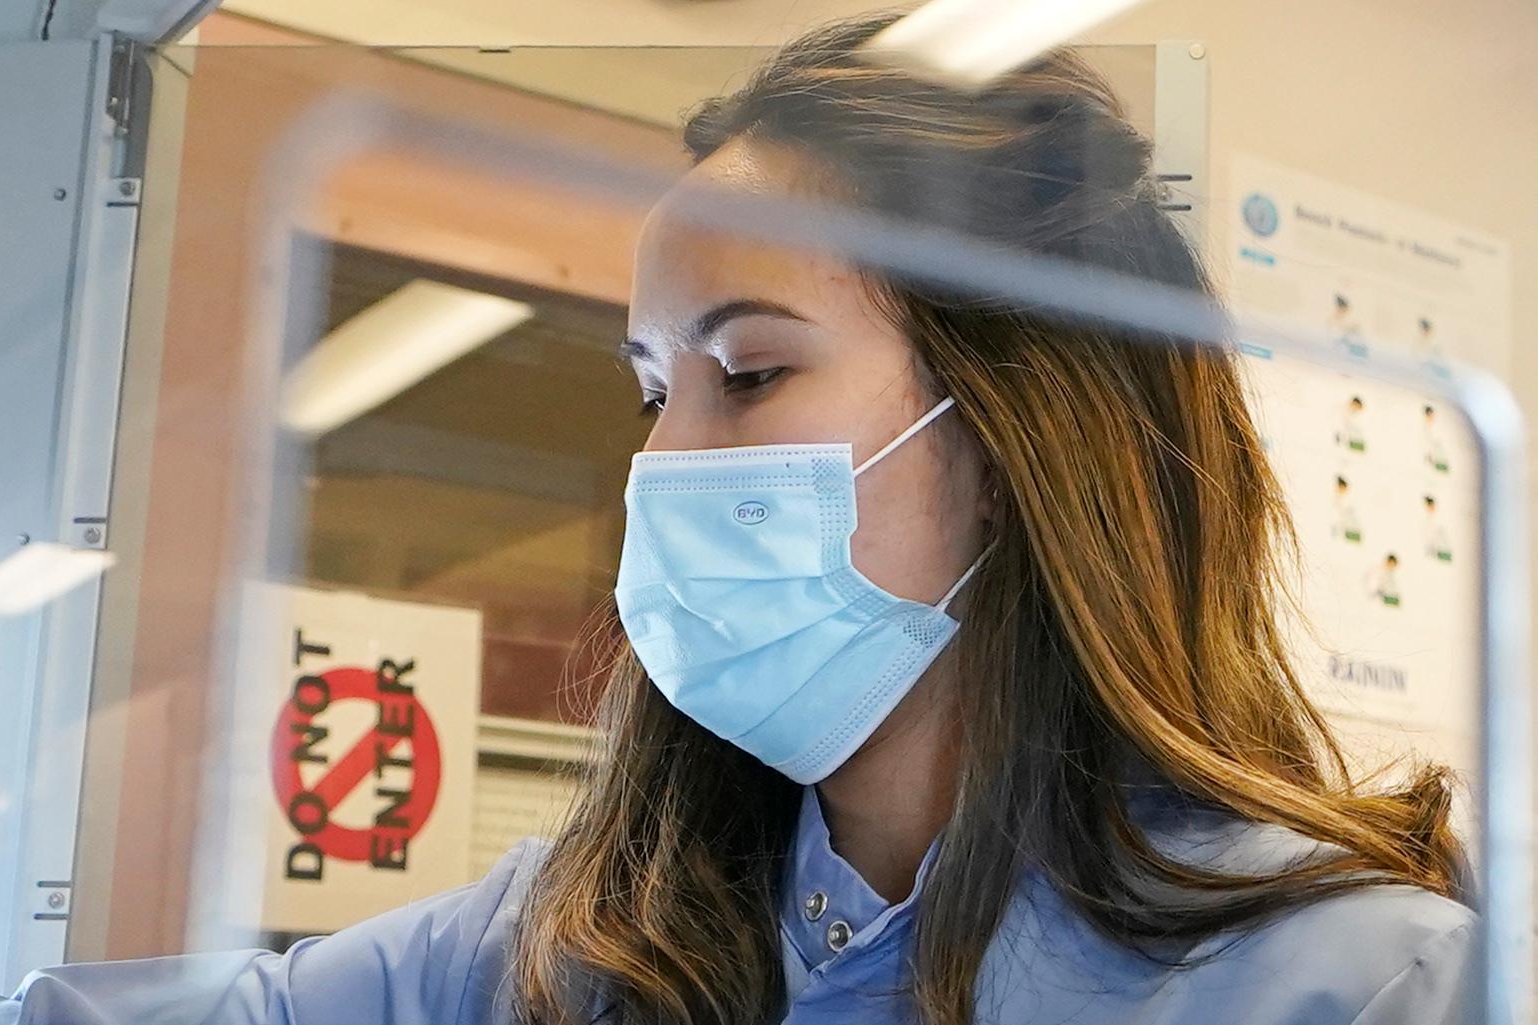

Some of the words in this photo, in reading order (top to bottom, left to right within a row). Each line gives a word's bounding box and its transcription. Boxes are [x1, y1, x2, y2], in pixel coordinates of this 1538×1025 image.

[737, 507, 765, 519] BYD
[290, 628, 331, 763] NOT
[371, 657, 416, 871] ENTER
[285, 791, 328, 881] DO
